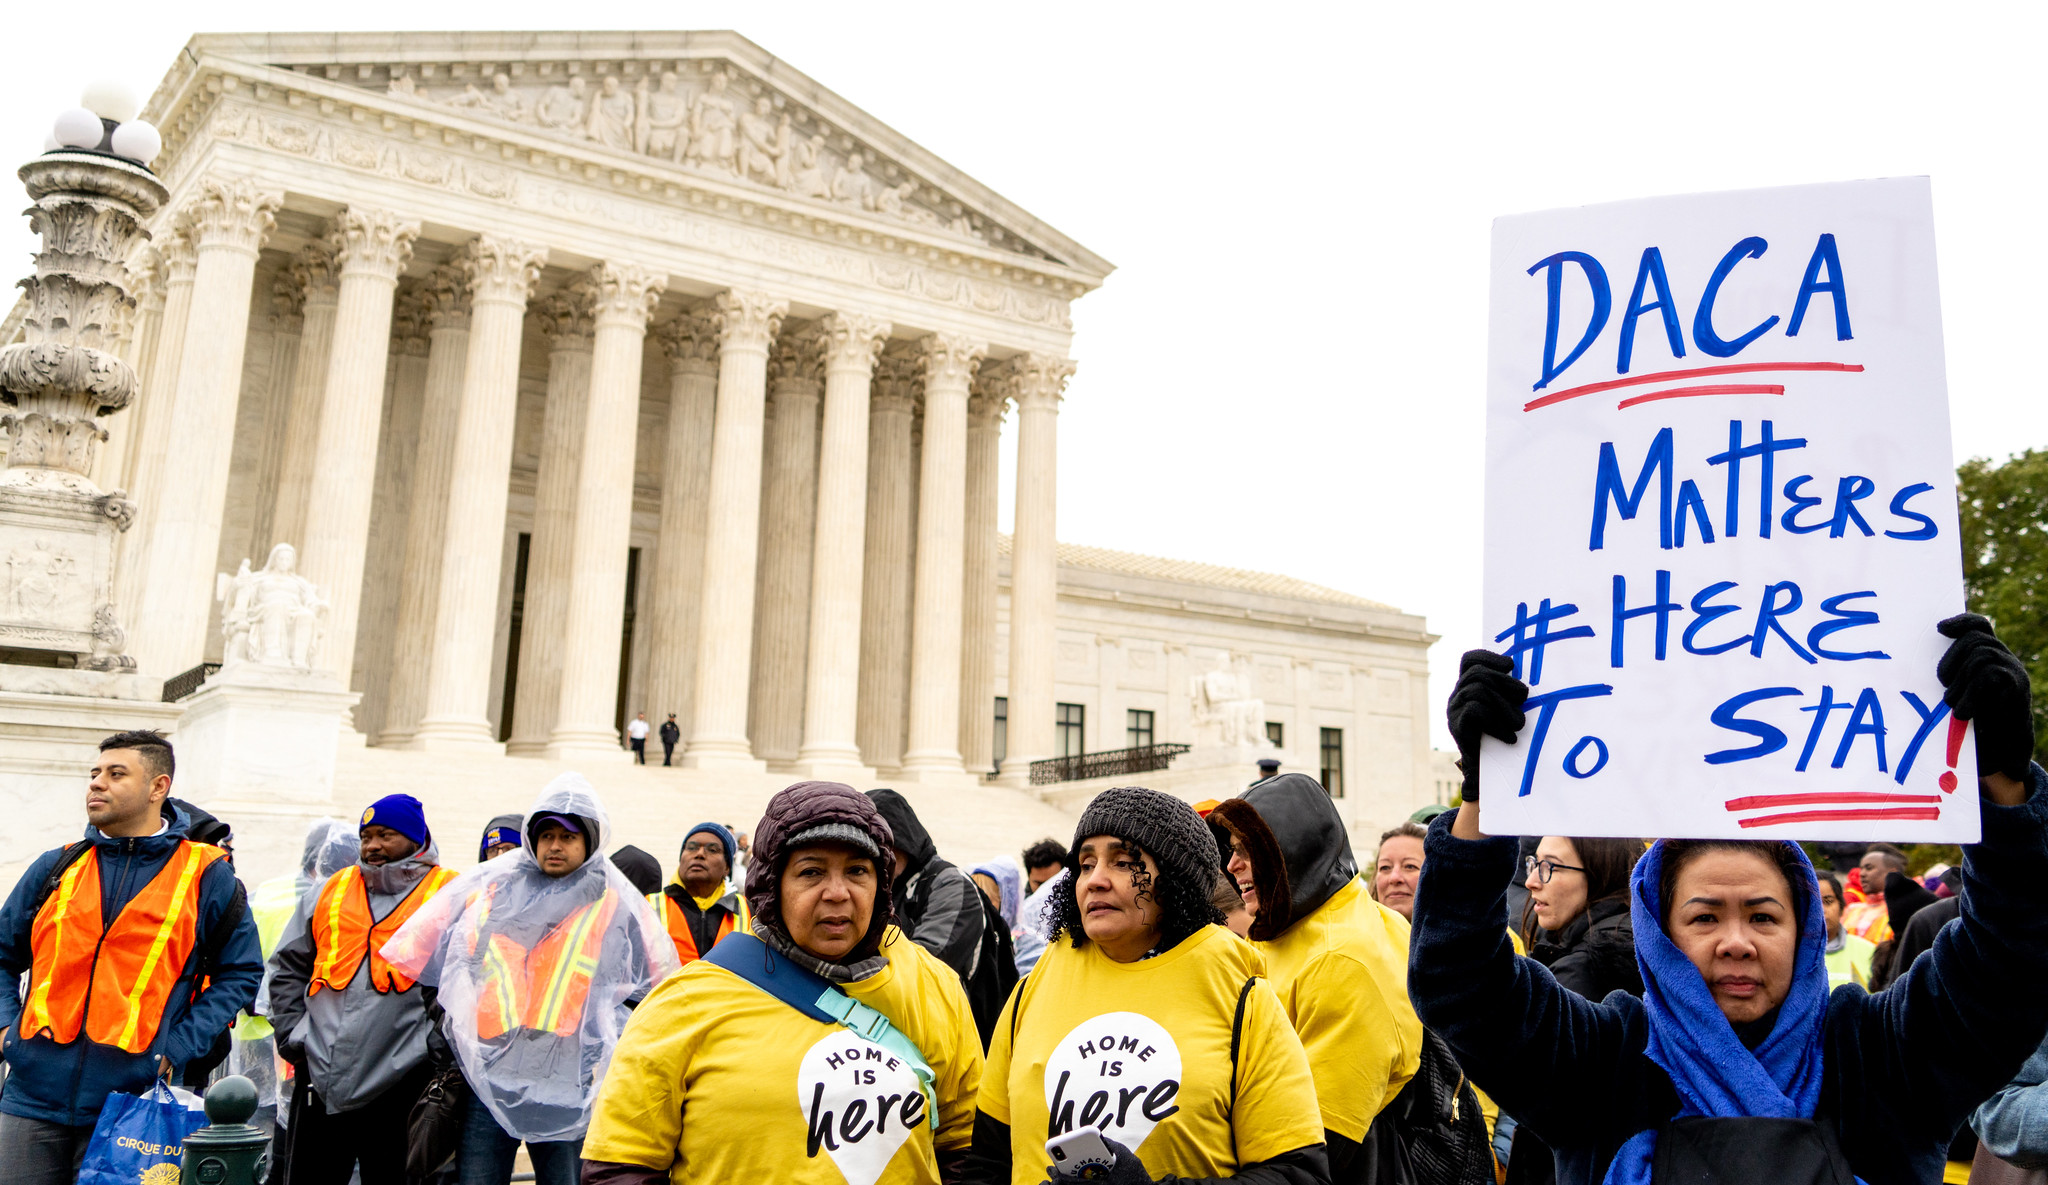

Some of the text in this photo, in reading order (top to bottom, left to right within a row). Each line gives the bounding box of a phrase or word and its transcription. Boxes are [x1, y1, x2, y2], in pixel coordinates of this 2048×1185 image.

[535, 182, 618, 222] EQUAL
[624, 206, 718, 246] JUSTICE
[730, 231, 802, 263] UNDER
[1526, 233, 1854, 391] DACA
[1589, 419, 1938, 552] MATTERS
[825, 1047, 900, 1072] HOME
[1078, 1035, 1157, 1063] HOME
[854, 1069, 877, 1086] IS
[1100, 1060, 1123, 1077] IS
[806, 1082, 926, 1158] here
[117, 1137, 161, 1155] CIRQUE
[164, 1146, 182, 1156] DU
[1070, 1157, 1114, 1177] UCHACHA
